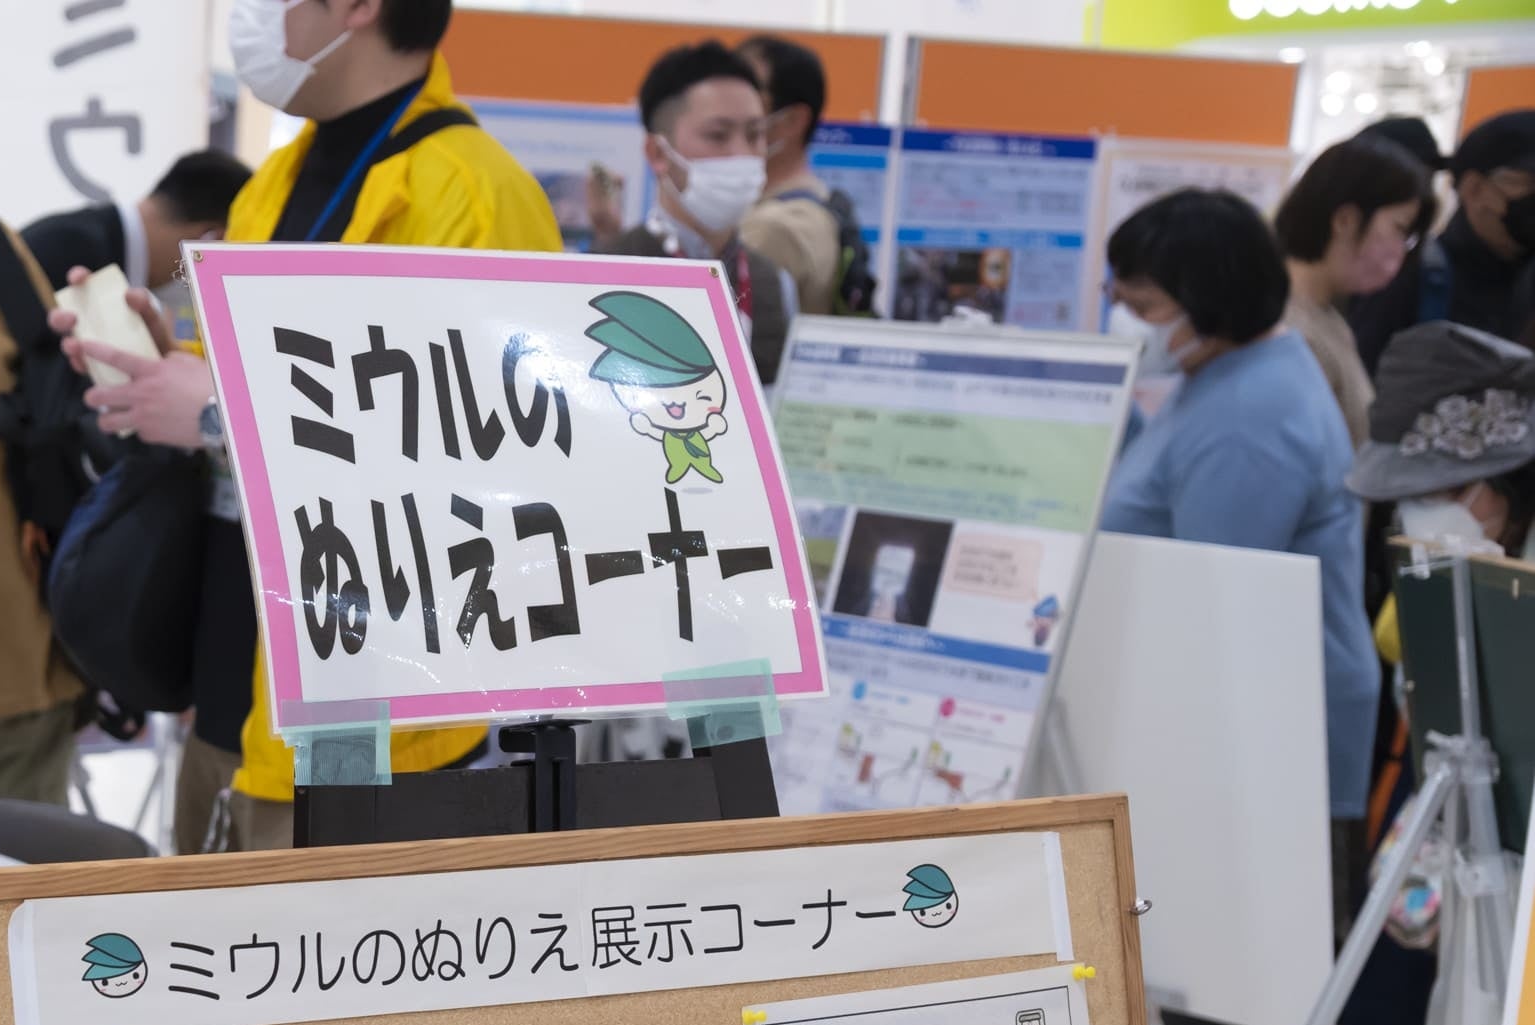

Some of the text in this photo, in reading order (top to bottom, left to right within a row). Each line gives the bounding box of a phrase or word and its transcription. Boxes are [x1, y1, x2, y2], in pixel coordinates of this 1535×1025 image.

[273, 324, 572, 464] ミウルの
[293, 486, 773, 660] ぬりえコーナー
[168, 889, 897, 1000] ミウルのぬりえ展示コーナー
